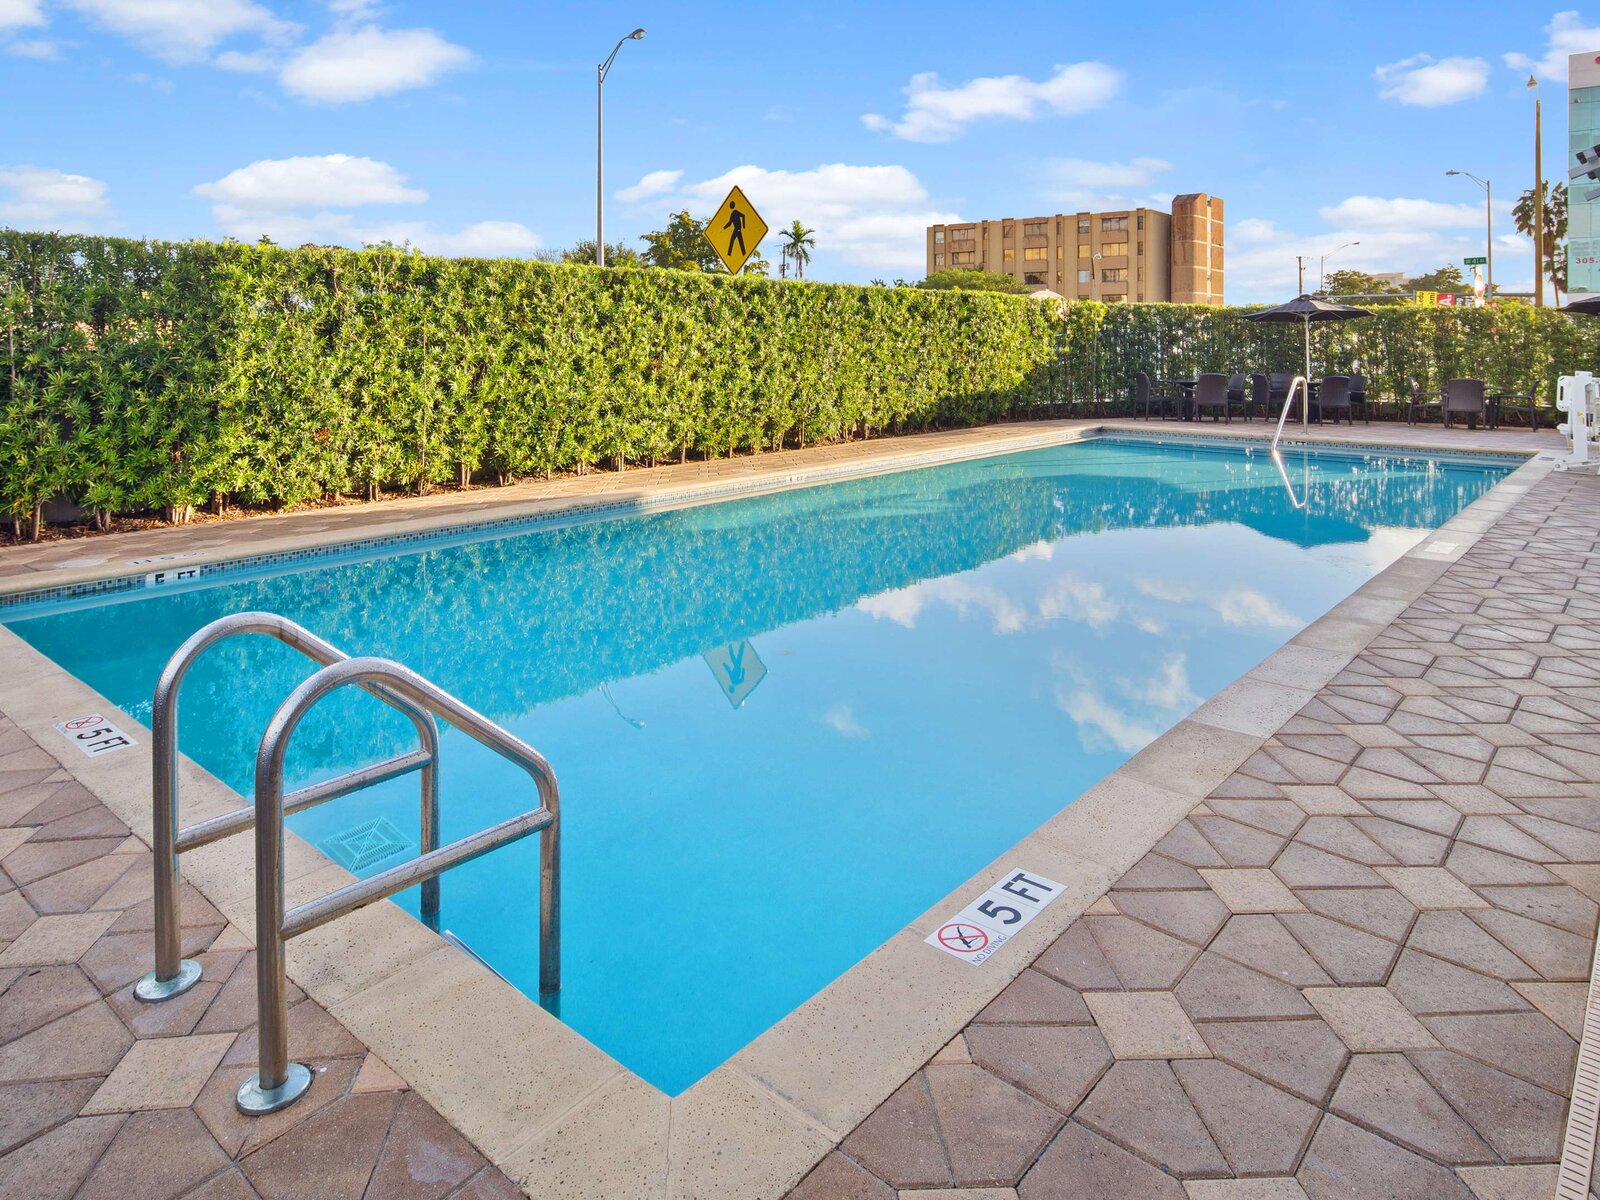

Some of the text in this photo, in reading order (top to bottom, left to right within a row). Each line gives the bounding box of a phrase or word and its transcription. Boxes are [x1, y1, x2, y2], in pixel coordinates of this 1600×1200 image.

[76, 727, 114, 740] 5
[87, 736, 130, 752] FT
[977, 872, 1053, 925] 5 FT
[971, 934, 1008, 964] NO DIVING
